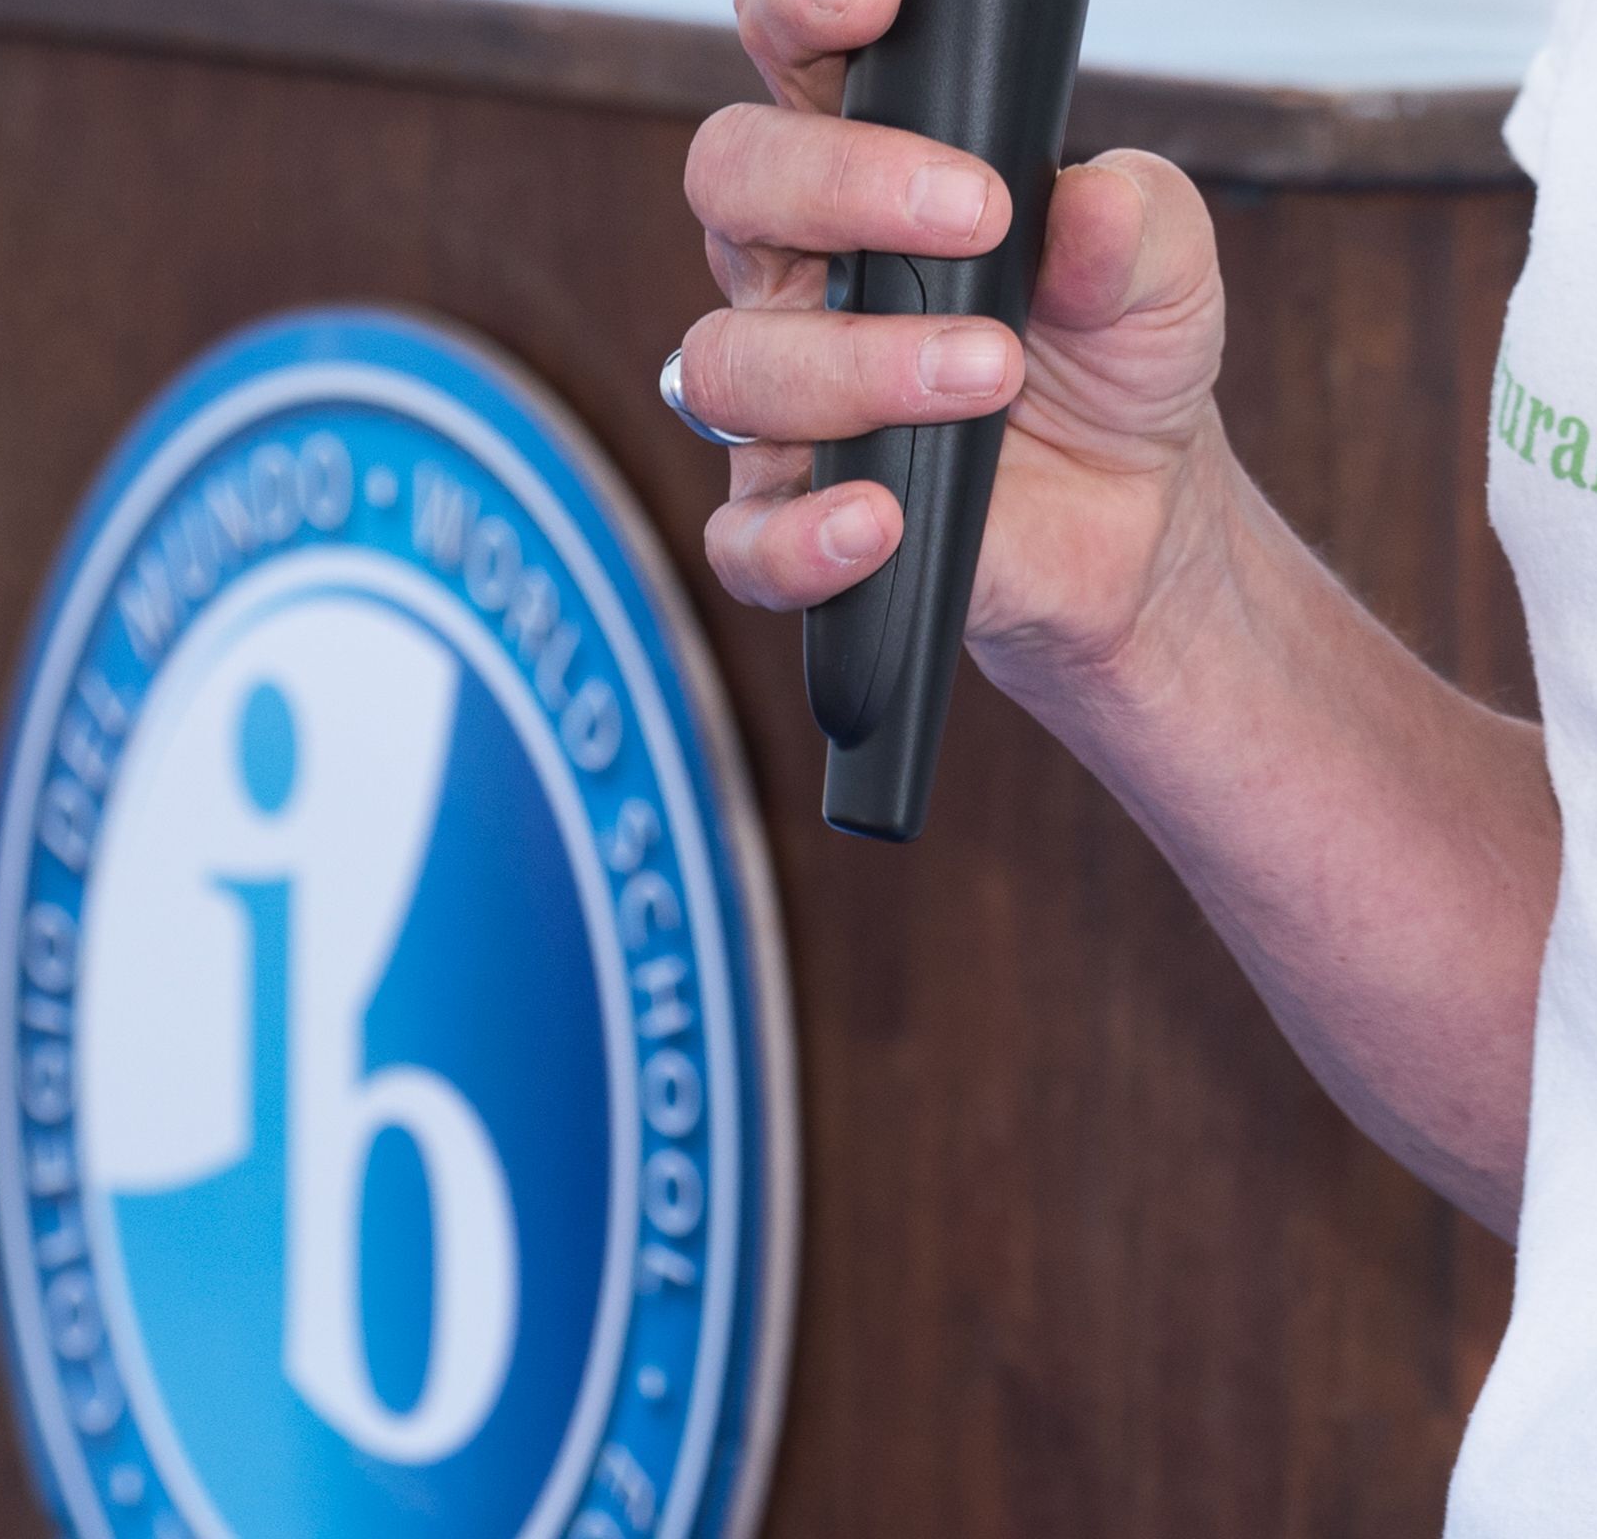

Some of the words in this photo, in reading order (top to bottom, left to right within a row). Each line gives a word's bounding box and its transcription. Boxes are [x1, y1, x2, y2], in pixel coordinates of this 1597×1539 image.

[117, 430, 354, 666] MUNDO
[411, 457, 624, 773] WORLD
[35, 665, 132, 878] DEL
[19, 900, 126, 1437] COLEGIO
[606, 797, 704, 1296] SCHOOL
